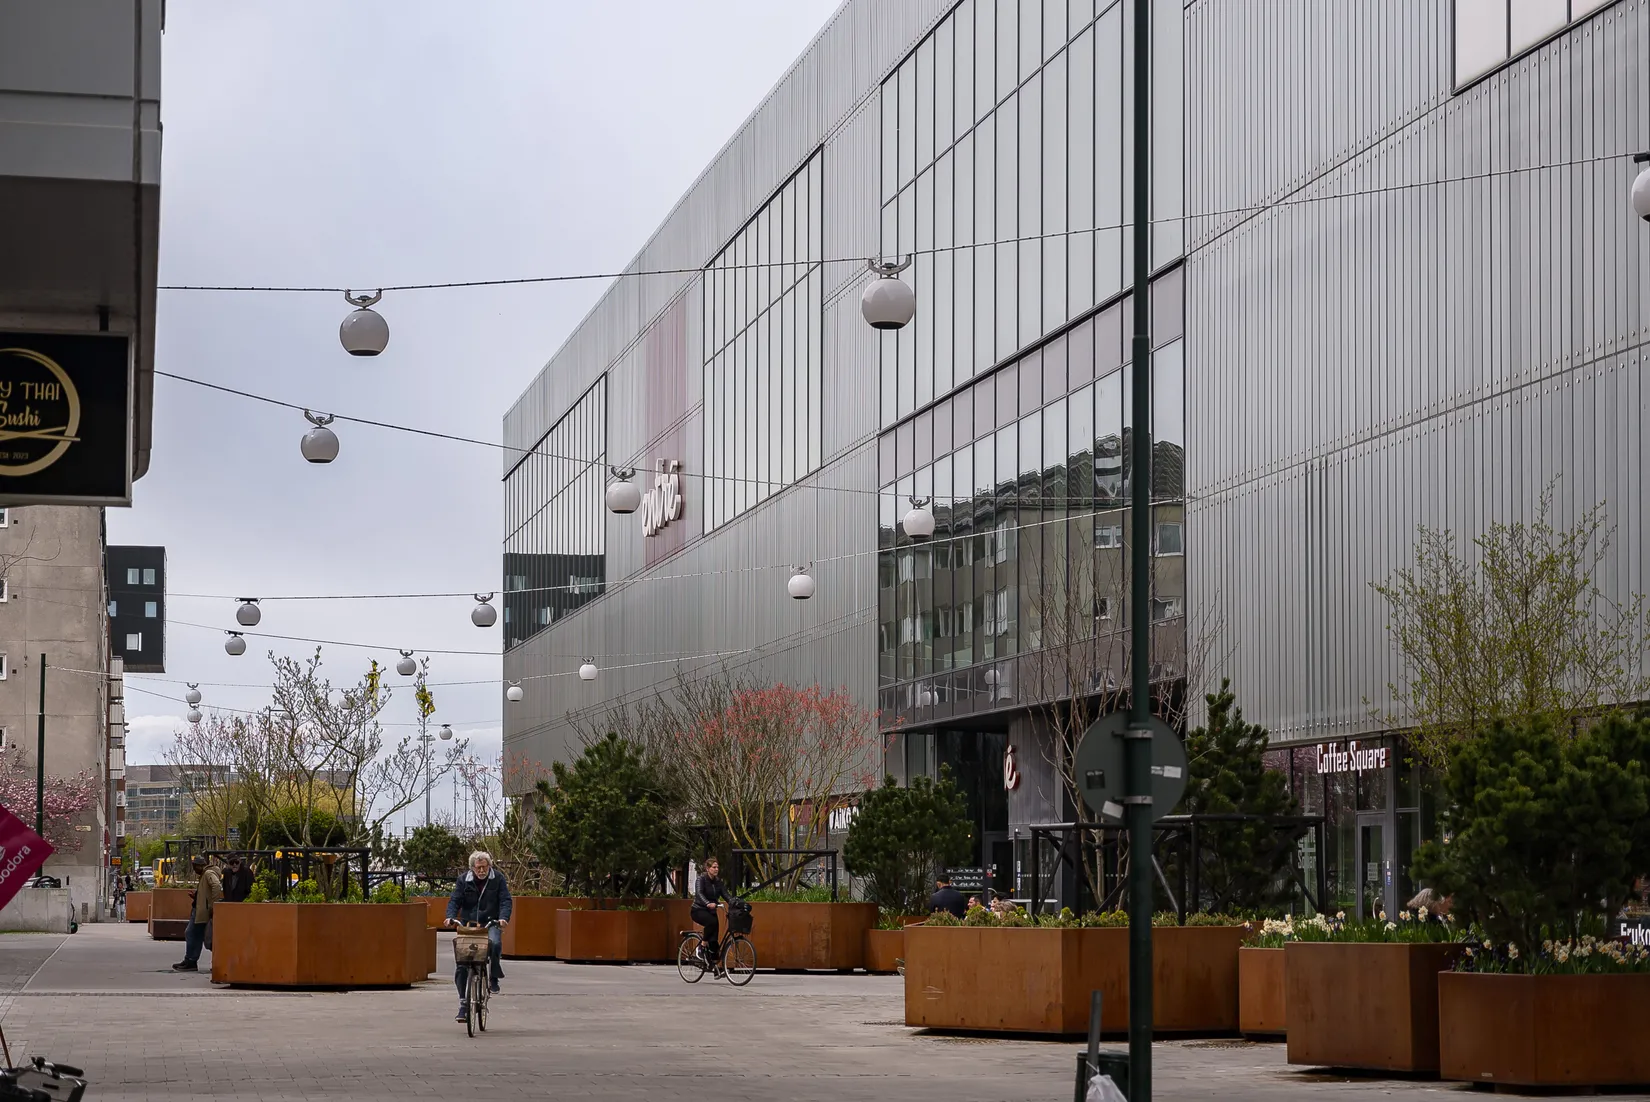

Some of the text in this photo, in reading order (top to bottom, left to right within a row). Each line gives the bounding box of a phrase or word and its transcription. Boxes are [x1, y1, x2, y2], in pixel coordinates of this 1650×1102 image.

[20, 382, 60, 400] THAI
[1317, 741, 1386, 777] Coffee Square
